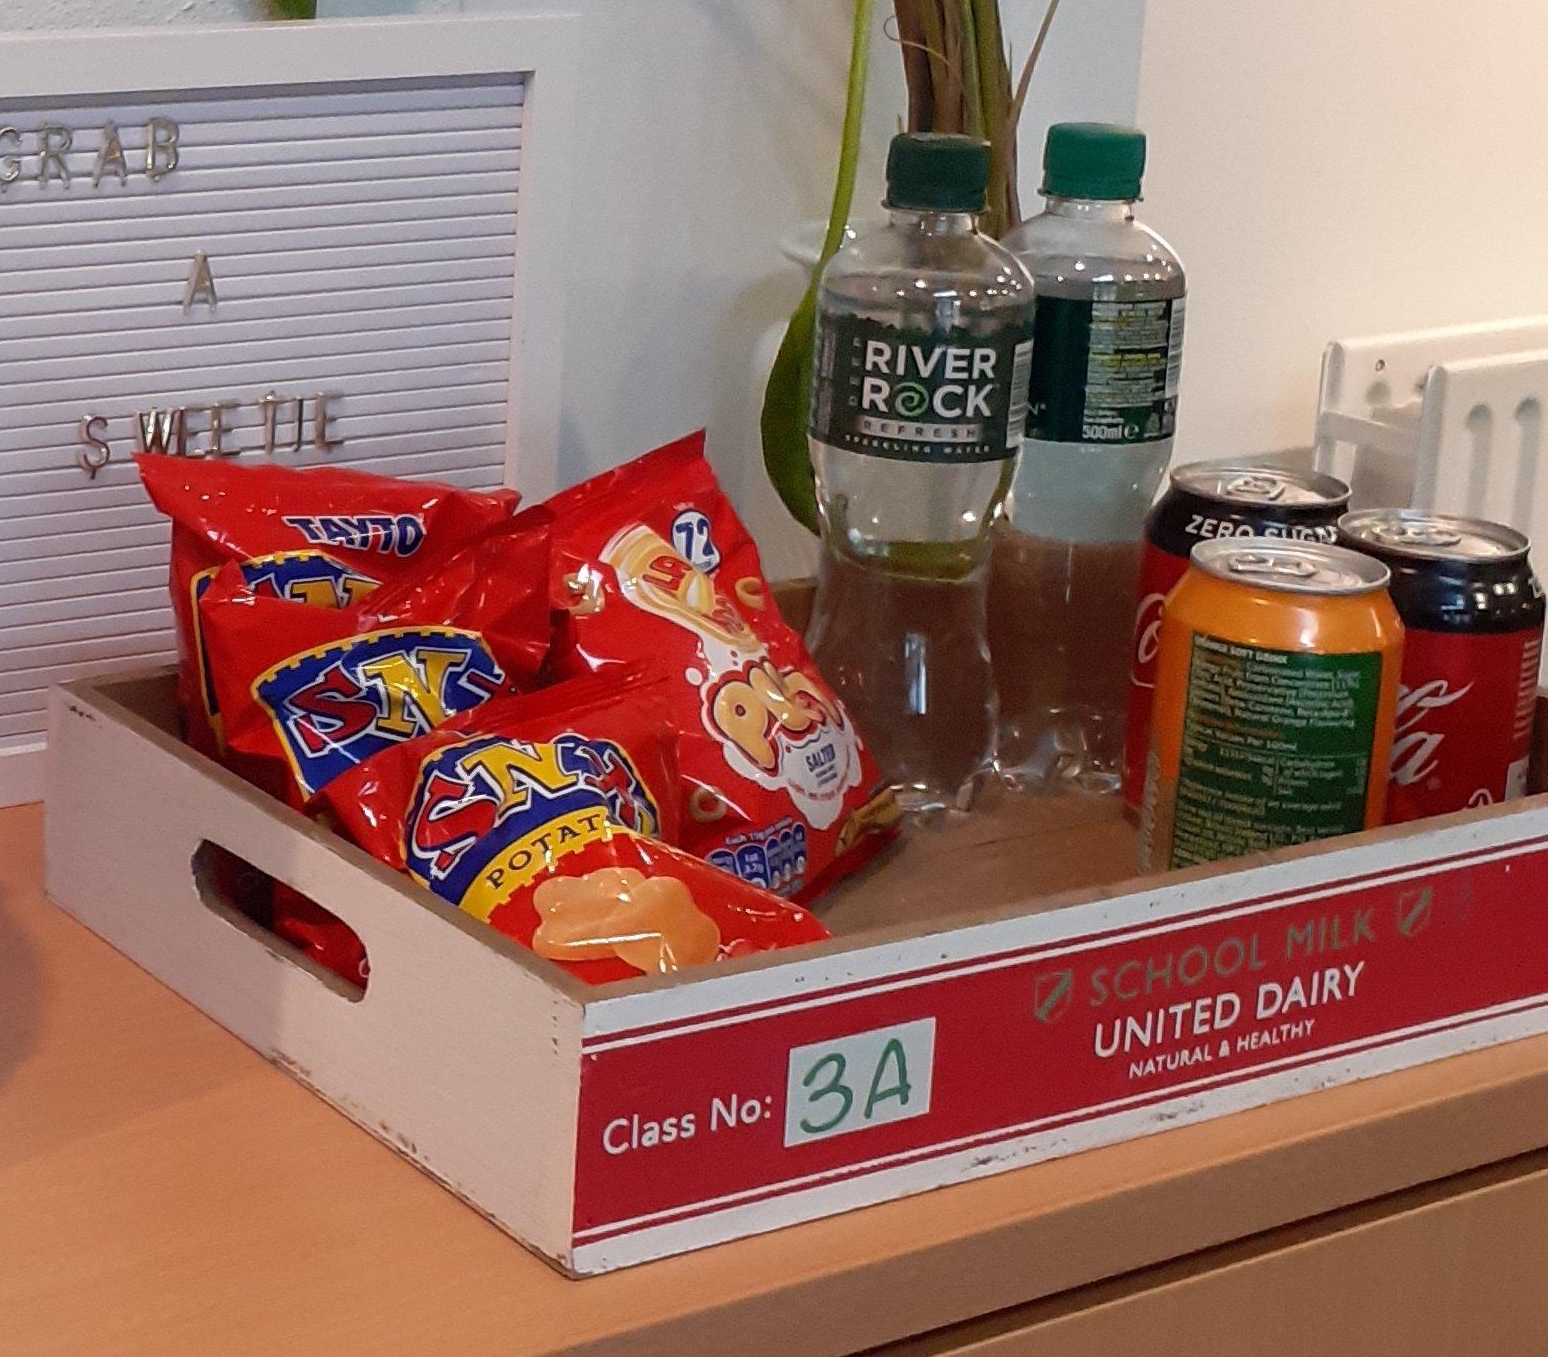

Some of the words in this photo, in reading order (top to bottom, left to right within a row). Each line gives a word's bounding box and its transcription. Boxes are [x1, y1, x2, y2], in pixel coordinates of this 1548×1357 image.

[183, 250, 218, 313] A
[864, 341, 997, 380] RIVER
[862, 377, 993, 419] ROCK
[861, 420, 977, 439] REFRESH
[1083, 425, 1123, 441] 500ml
[283, 515, 425, 557] TAYTO
[675, 518, 715, 561] 72
[1184, 514, 1255, 538] ZERO
[486, 812, 605, 890] POTAT
[1090, 937, 1267, 1007] SCHOOL
[1285, 907, 1376, 961] MILK
[1093, 992, 1241, 1058] UNITED
[1256, 960, 1366, 1021] DAIRY
[1128, 1045, 1213, 1079] NATURAL
[1237, 1019, 1315, 1053] HEALTHY
[800, 1038, 912, 1134] 3A
[602, 1113, 696, 1155] Class
[710, 1093, 773, 1131] No:
